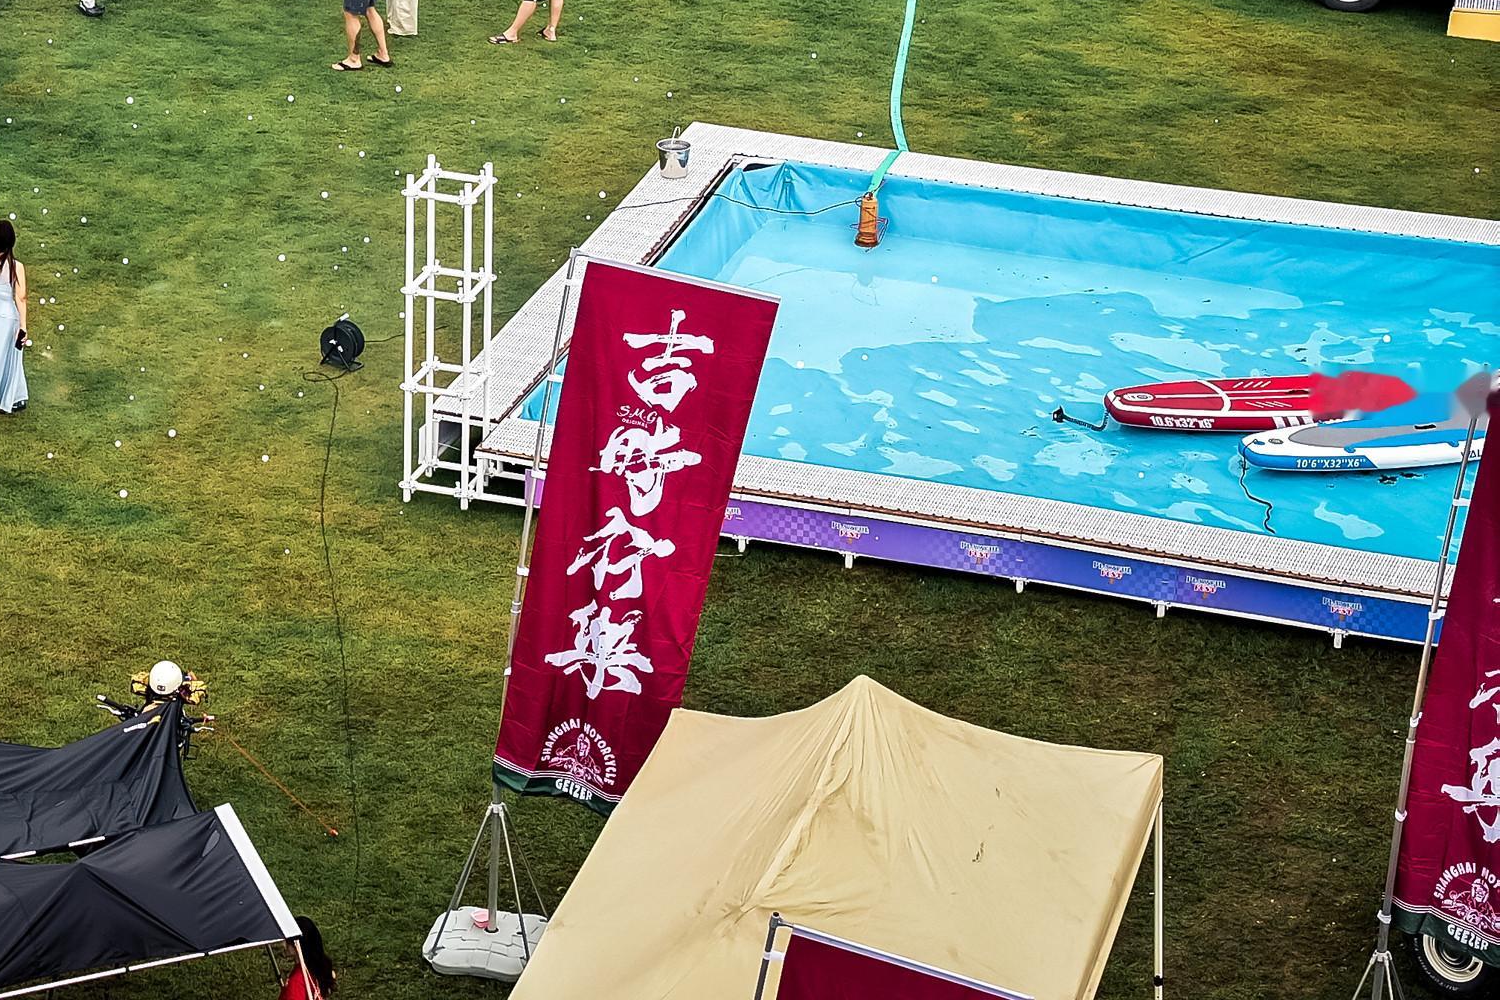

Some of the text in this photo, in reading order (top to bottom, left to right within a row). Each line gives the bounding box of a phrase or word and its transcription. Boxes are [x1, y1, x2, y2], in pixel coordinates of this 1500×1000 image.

[541, 718, 617, 786] SHANGHAI MOTORCYCLE
[1433, 861, 1477, 899] SHANGHAI
[1447, 923, 1489, 951] GEEZER
